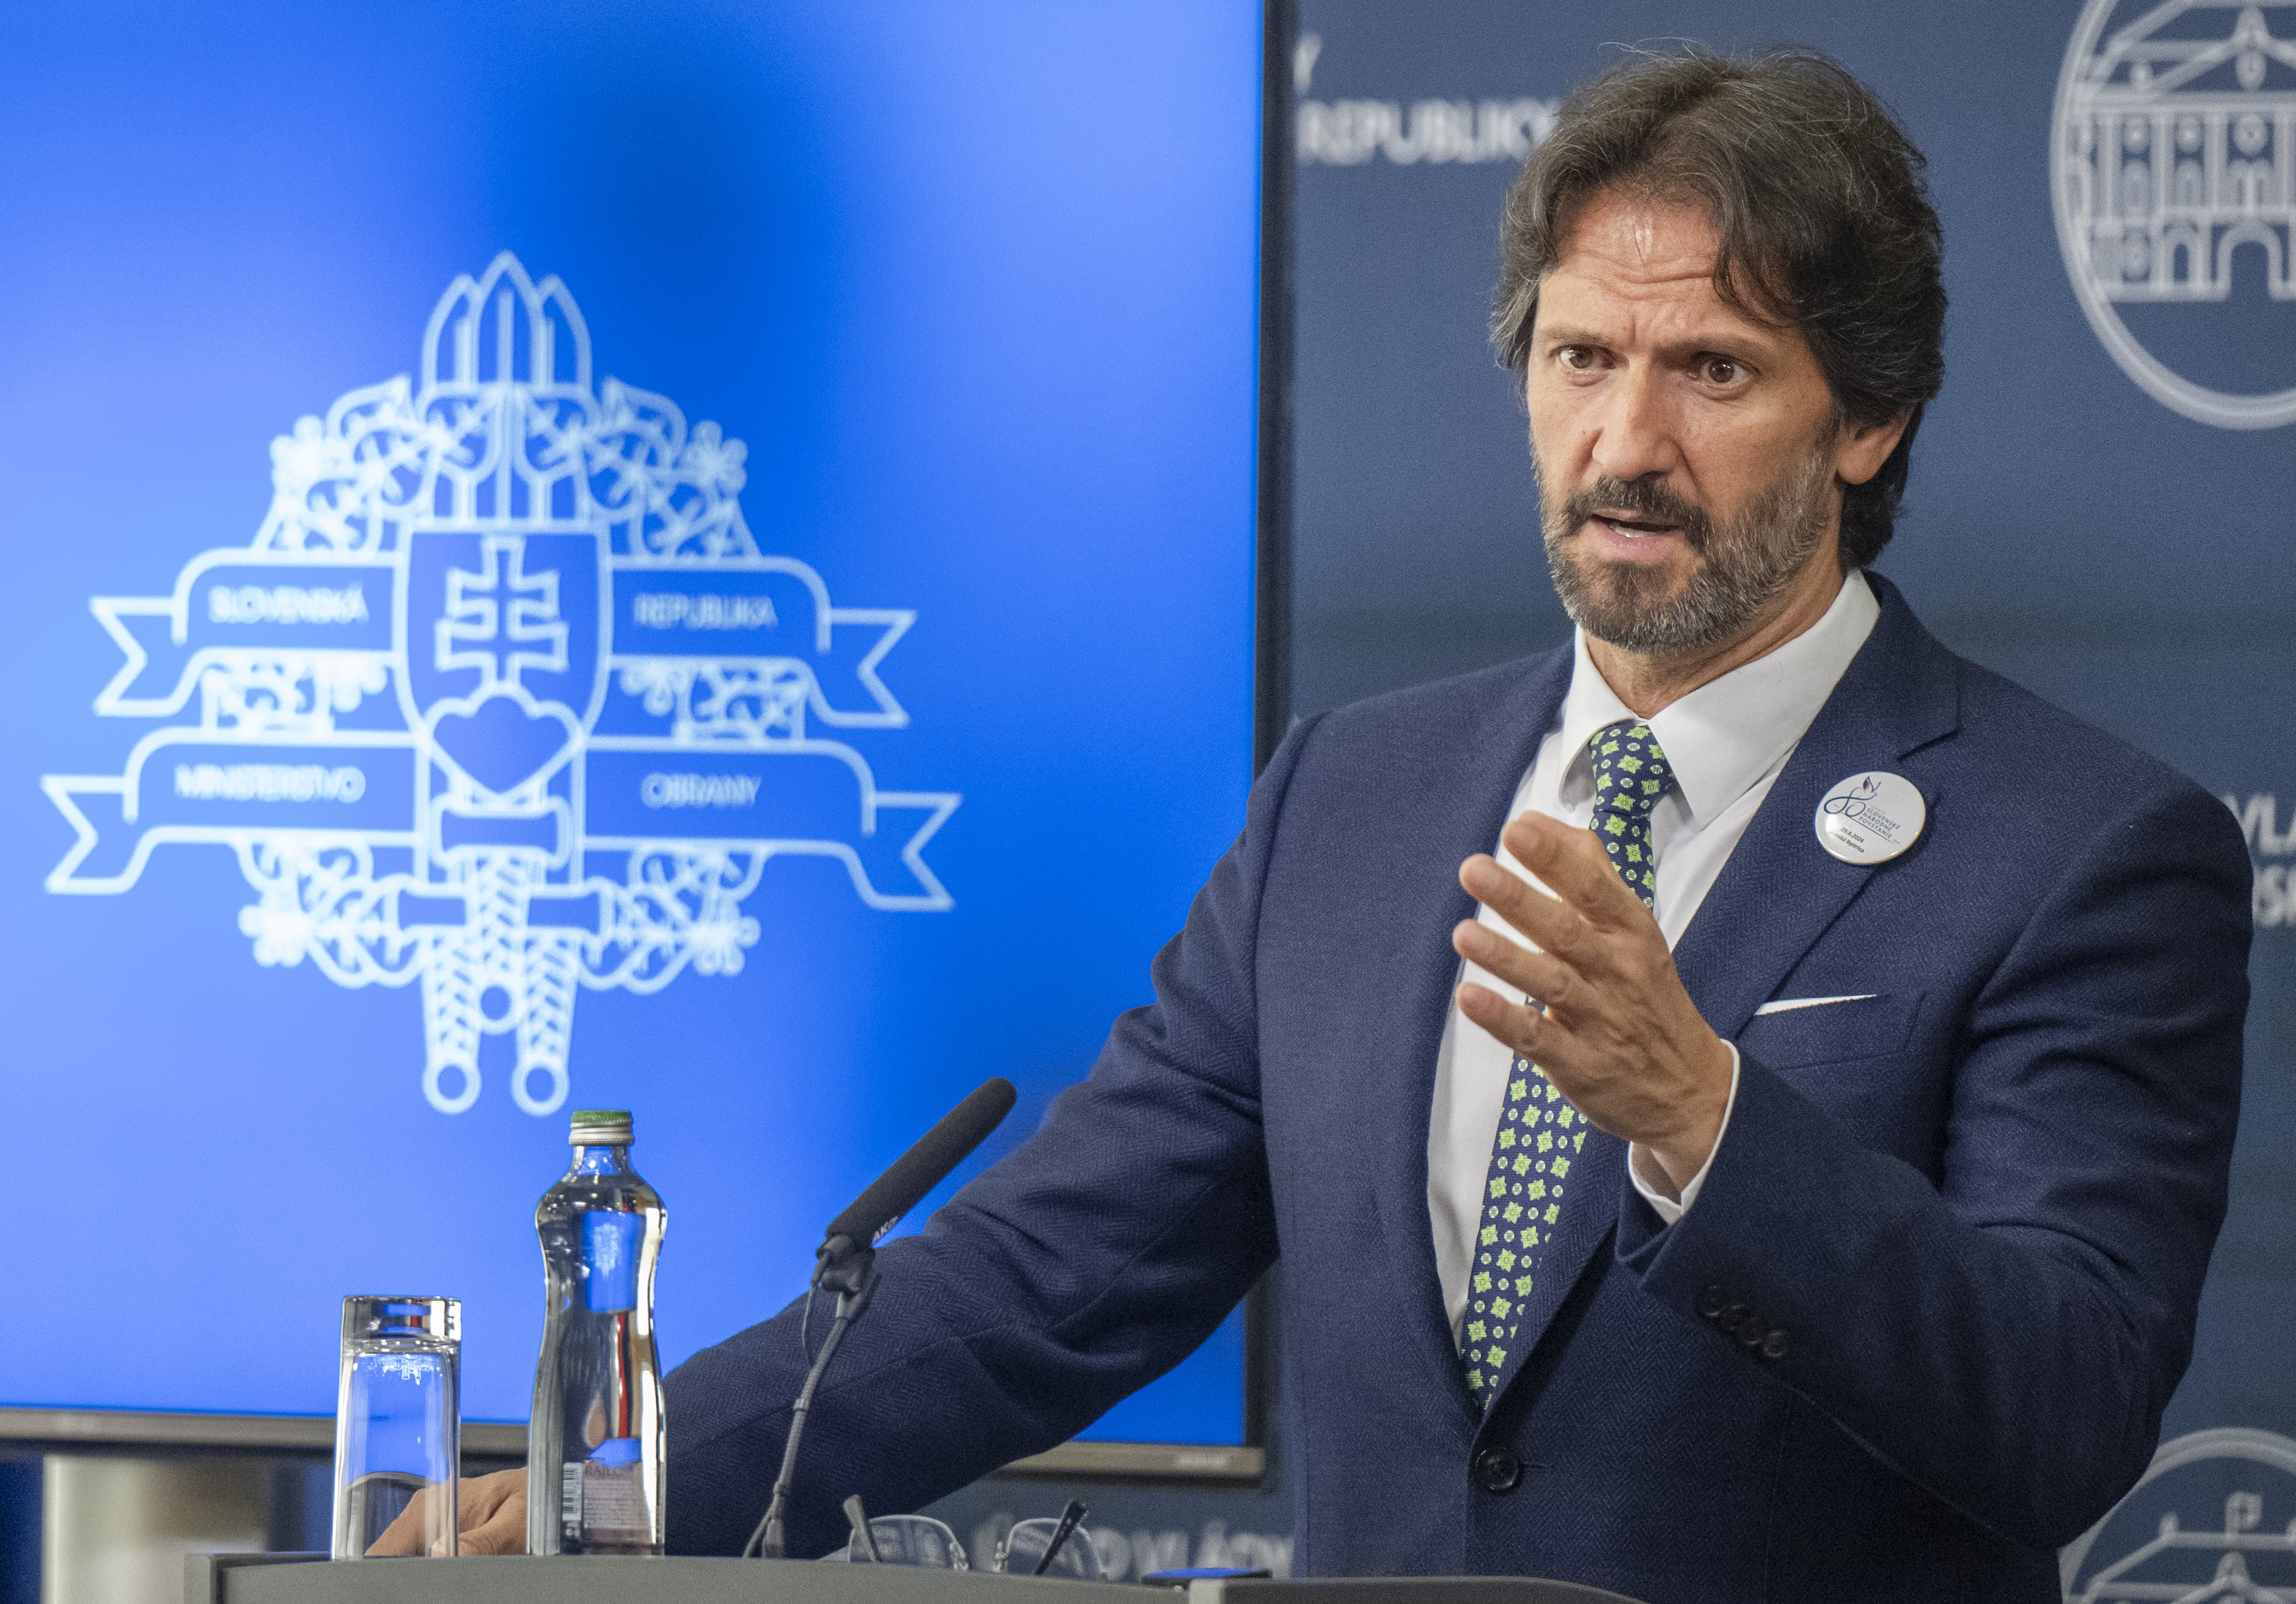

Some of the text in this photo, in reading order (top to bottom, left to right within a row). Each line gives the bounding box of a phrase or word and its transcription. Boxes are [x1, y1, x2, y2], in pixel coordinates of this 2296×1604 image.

[641, 772, 762, 808] OBRANY
[1859, 816, 1892, 839] POVSTANIE
[1867, 807, 1901, 830] SLOVENSKÉ
[1846, 839, 1865, 853] Bystrica
